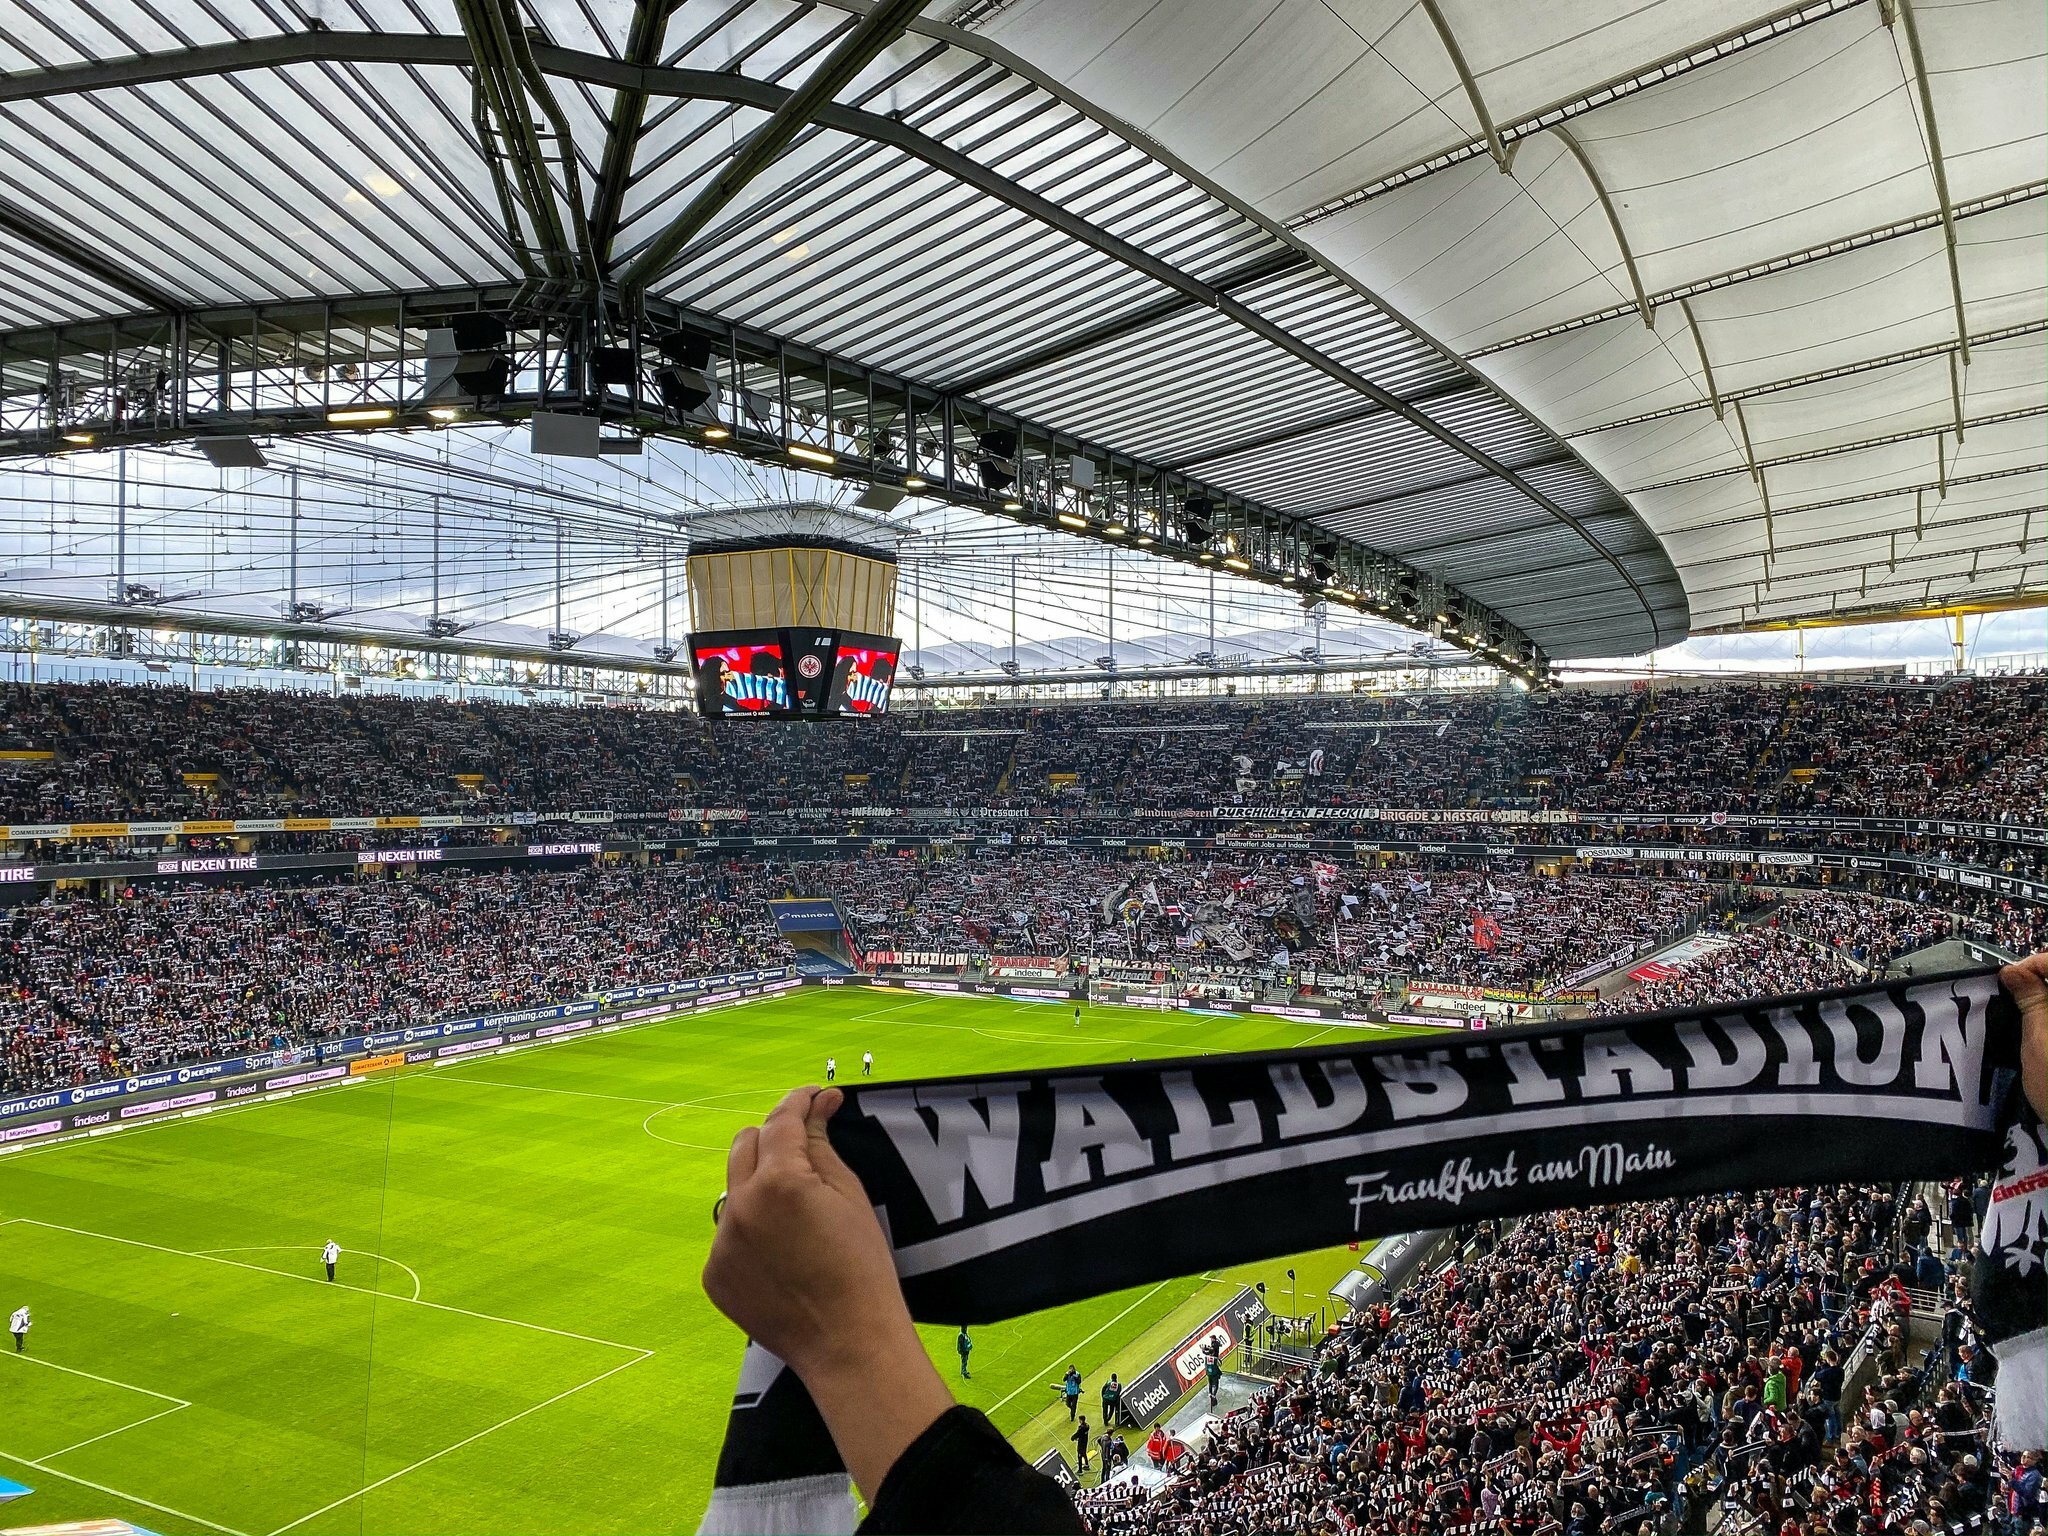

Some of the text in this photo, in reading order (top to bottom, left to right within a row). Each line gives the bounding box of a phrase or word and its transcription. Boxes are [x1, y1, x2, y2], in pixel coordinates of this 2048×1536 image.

[545, 812, 571, 820] BLACK
[851, 807, 892, 817] INFERNO
[980, 807, 1029, 817] Presswerk
[1134, 807, 1178, 818] Binding
[1216, 807, 1309, 818] DURCHHALTEN
[1380, 810, 1488, 822] BRIGADE NASSAU
[697, 839, 720, 847] indeed
[753, 838, 778, 846] indeed
[813, 837, 837, 845] indeed
[872, 837, 896, 845] indeed
[929, 837, 953, 845] indeed
[1102, 838, 1126, 846] indeed
[1161, 839, 1185, 847] indeed
[1227, 840, 1259, 848] Volltreffer!
[1352, 842, 1380, 850] indeed
[545, 843, 601, 854] NEXEN TIRE
[1419, 844, 1446, 853] indeed
[1486, 845, 1515, 855] indeed
[377, 851, 414, 862] NEXEN
[416, 849, 442, 860] TIRE
[1582, 848, 1628, 857] POSSMANN
[1640, 849, 1687, 860] FRANKFURT,
[1688, 850, 1703, 860] GIB
[1706, 849, 1754, 862] STÖFFSCHE!
[1765, 852, 1810, 864] POSSMANN
[181, 859, 225, 872] NEXEN
[228, 857, 257, 869] TIRE
[0, 867, 34, 881] TIRE
[866, 950, 968, 966] WALDSTADION
[991, 955, 1052, 968] FRANKFURT
[902, 964, 931, 974] indeed
[1112, 959, 1171, 970] ULTRAS
[1014, 968, 1042, 977] indeed
[1103, 968, 1153, 981] Eintracht
[870, 978, 890, 986] indeed
[1411, 980, 1474, 993] EINTRACHT
[645, 987, 665, 995] KERN
[744, 987, 760, 996] indeed
[975, 985, 995, 993] indeed
[1324, 986, 1357, 999] indeed
[613, 990, 634, 999] KERN
[572, 1003, 594, 1012] KERN
[676, 1000, 693, 1010] indeed
[1208, 1000, 1232, 1010] indeed
[1453, 1000, 1486, 1012] indeed
[483, 1008, 557, 1027] kerntraining.com
[597, 1015, 616, 1025] indeed
[1341, 1010, 1368, 1021] indeed
[452, 1022, 477, 1032] KERN
[414, 1028, 439, 1038] KERN
[508, 1032, 530, 1042] indeed
[374, 1035, 399, 1045] KERN
[406, 1050, 431, 1062] indeed
[245, 1056, 273, 1070] Spra
[351, 1061, 383, 1071] COMMERZBANK
[190, 1065, 222, 1078] KERN
[309, 1071, 330, 1080] München
[139, 1074, 172, 1087] KERN
[85, 1084, 120, 1097] KERN
[225, 1083, 257, 1098] indeed
[0, 1094, 60, 1116] ern.com
[172, 1097, 197, 1106] München
[857, 975, 2000, 1225] WALDSTADION
[72, 1111, 110, 1128] indeed
[9, 1127, 37, 1138] München
[1346, 1142, 1676, 1232] Frankfurt am Main
[1131, 1379, 1170, 1417] indeed
[1182, 1353, 1205, 1375] Jobs
